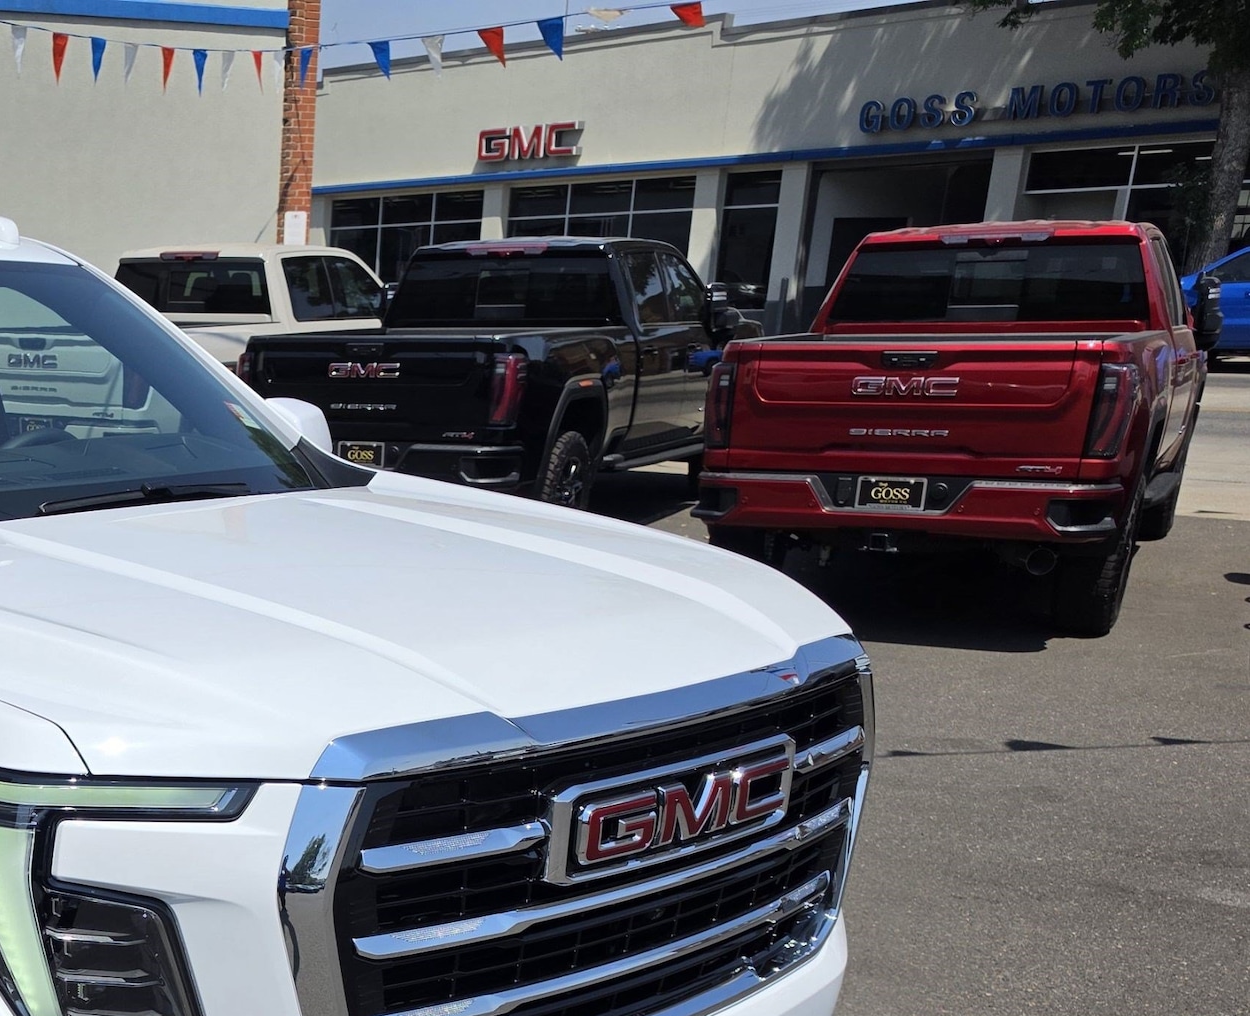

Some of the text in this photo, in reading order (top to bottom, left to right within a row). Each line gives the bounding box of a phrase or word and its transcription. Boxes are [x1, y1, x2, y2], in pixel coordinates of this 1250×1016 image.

[858, 69, 1216, 134] GOSS MOTORS
[477, 120, 582, 162] GMC
[7, 353, 58, 369] GMC
[328, 362, 400, 378] GMC
[851, 376, 960, 397] GMC
[849, 428, 950, 437] SIERRA
[347, 449, 374, 461] GOSS
[871, 486, 910, 500] GOSS
[578, 756, 791, 865] GMC
